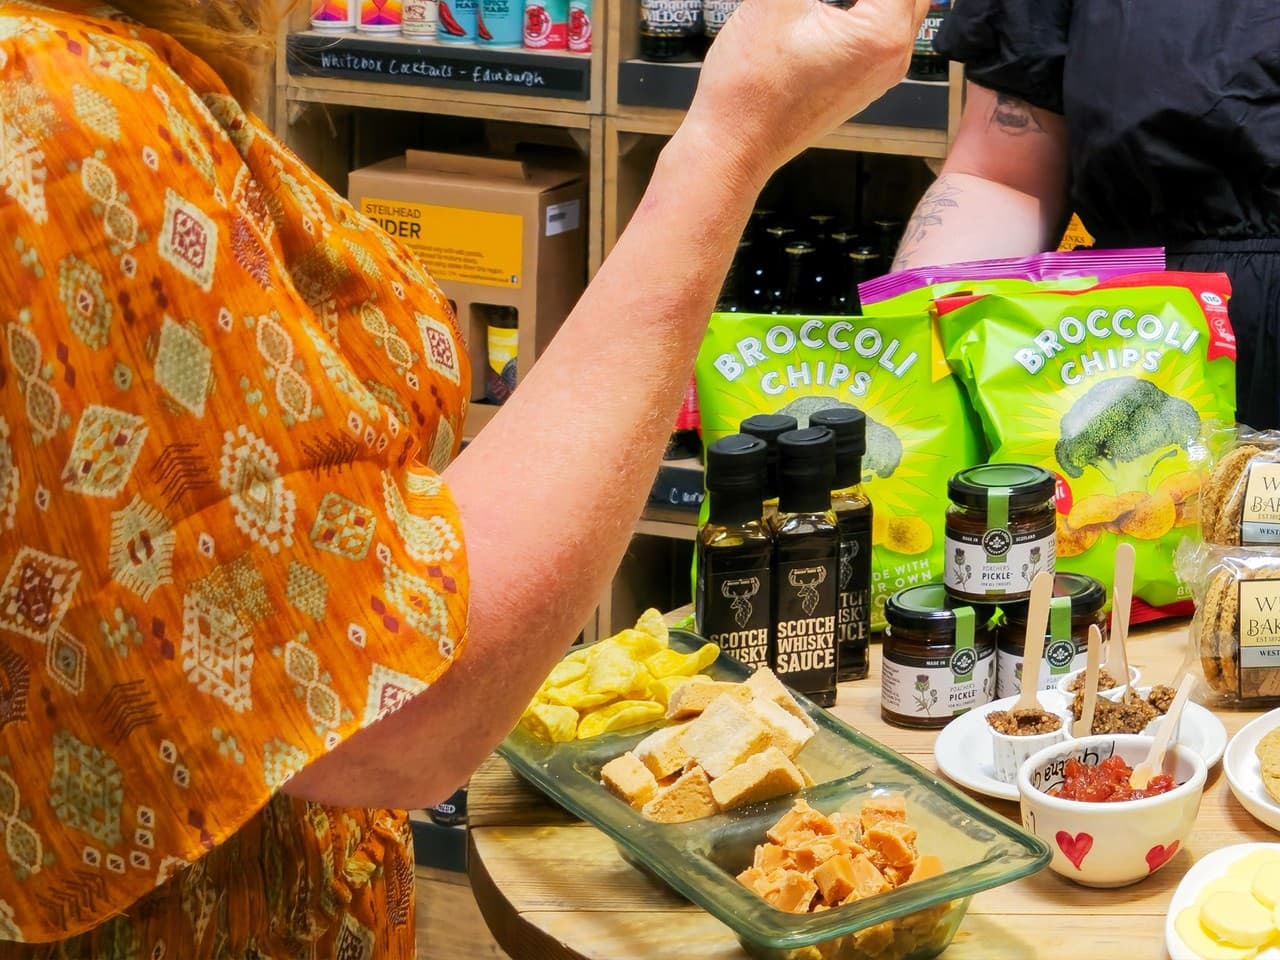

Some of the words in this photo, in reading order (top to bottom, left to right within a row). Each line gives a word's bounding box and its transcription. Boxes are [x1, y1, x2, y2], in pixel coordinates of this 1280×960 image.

[321, 52, 382, 72] Whitebox
[389, 60, 452, 77] Cocktails
[472, 67, 545, 86] Edinburgh
[366, 203, 421, 219] STEILHEAD
[368, 217, 422, 239] IDER
[713, 319, 918, 382] BROCCOLI
[1013, 308, 1199, 375] BROCCOLI
[1060, 348, 1162, 385] CHIPS
[761, 361, 872, 396] CHIPS
[894, 558, 930, 576] WITH
[895, 570, 932, 588] OWN
[777, 616, 836, 638] SCOTCH
[710, 628, 768, 649] SCOTCH
[777, 634, 834, 654] WHISKY
[777, 649, 835, 674] SAUCE
